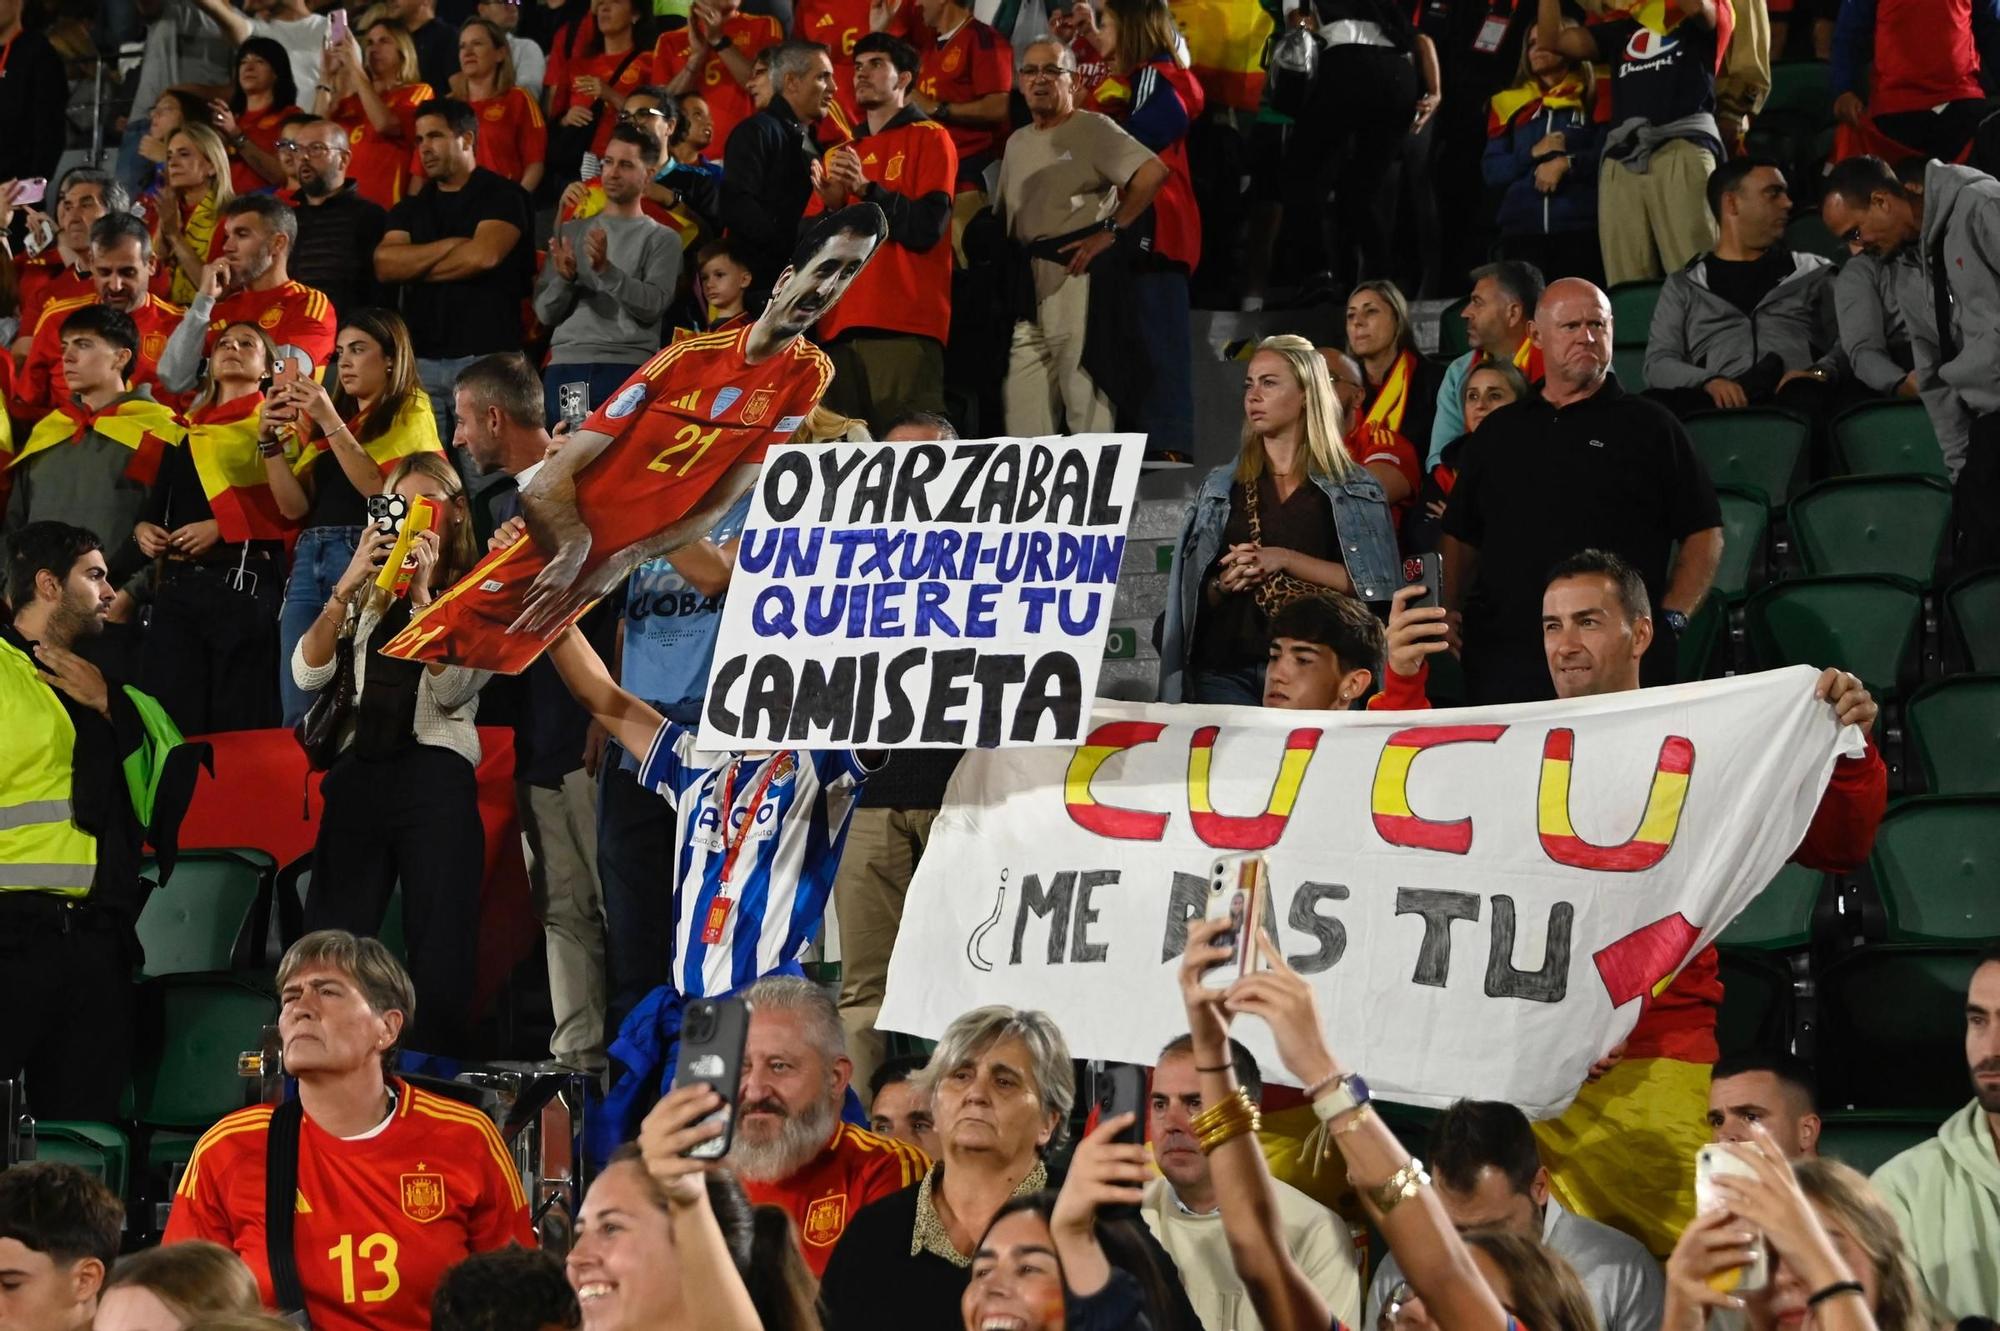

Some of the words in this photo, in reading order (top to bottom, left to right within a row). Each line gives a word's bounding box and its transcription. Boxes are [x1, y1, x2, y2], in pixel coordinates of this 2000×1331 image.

[705, 59, 721, 85] 6
[647, 423, 722, 478] 21
[762, 443, 1123, 526] OYARZABAL
[738, 527, 824, 579] UN
[830, 528, 1126, 583] TXURI-URDIN
[752, 582, 1002, 640] QUIERE
[1018, 586, 1102, 636] TU
[707, 647, 1083, 748] CAMISETA
[1161, 871, 1350, 975] DS
[1395, 886, 1574, 1003] TU
[328, 1232, 400, 1303] 13
